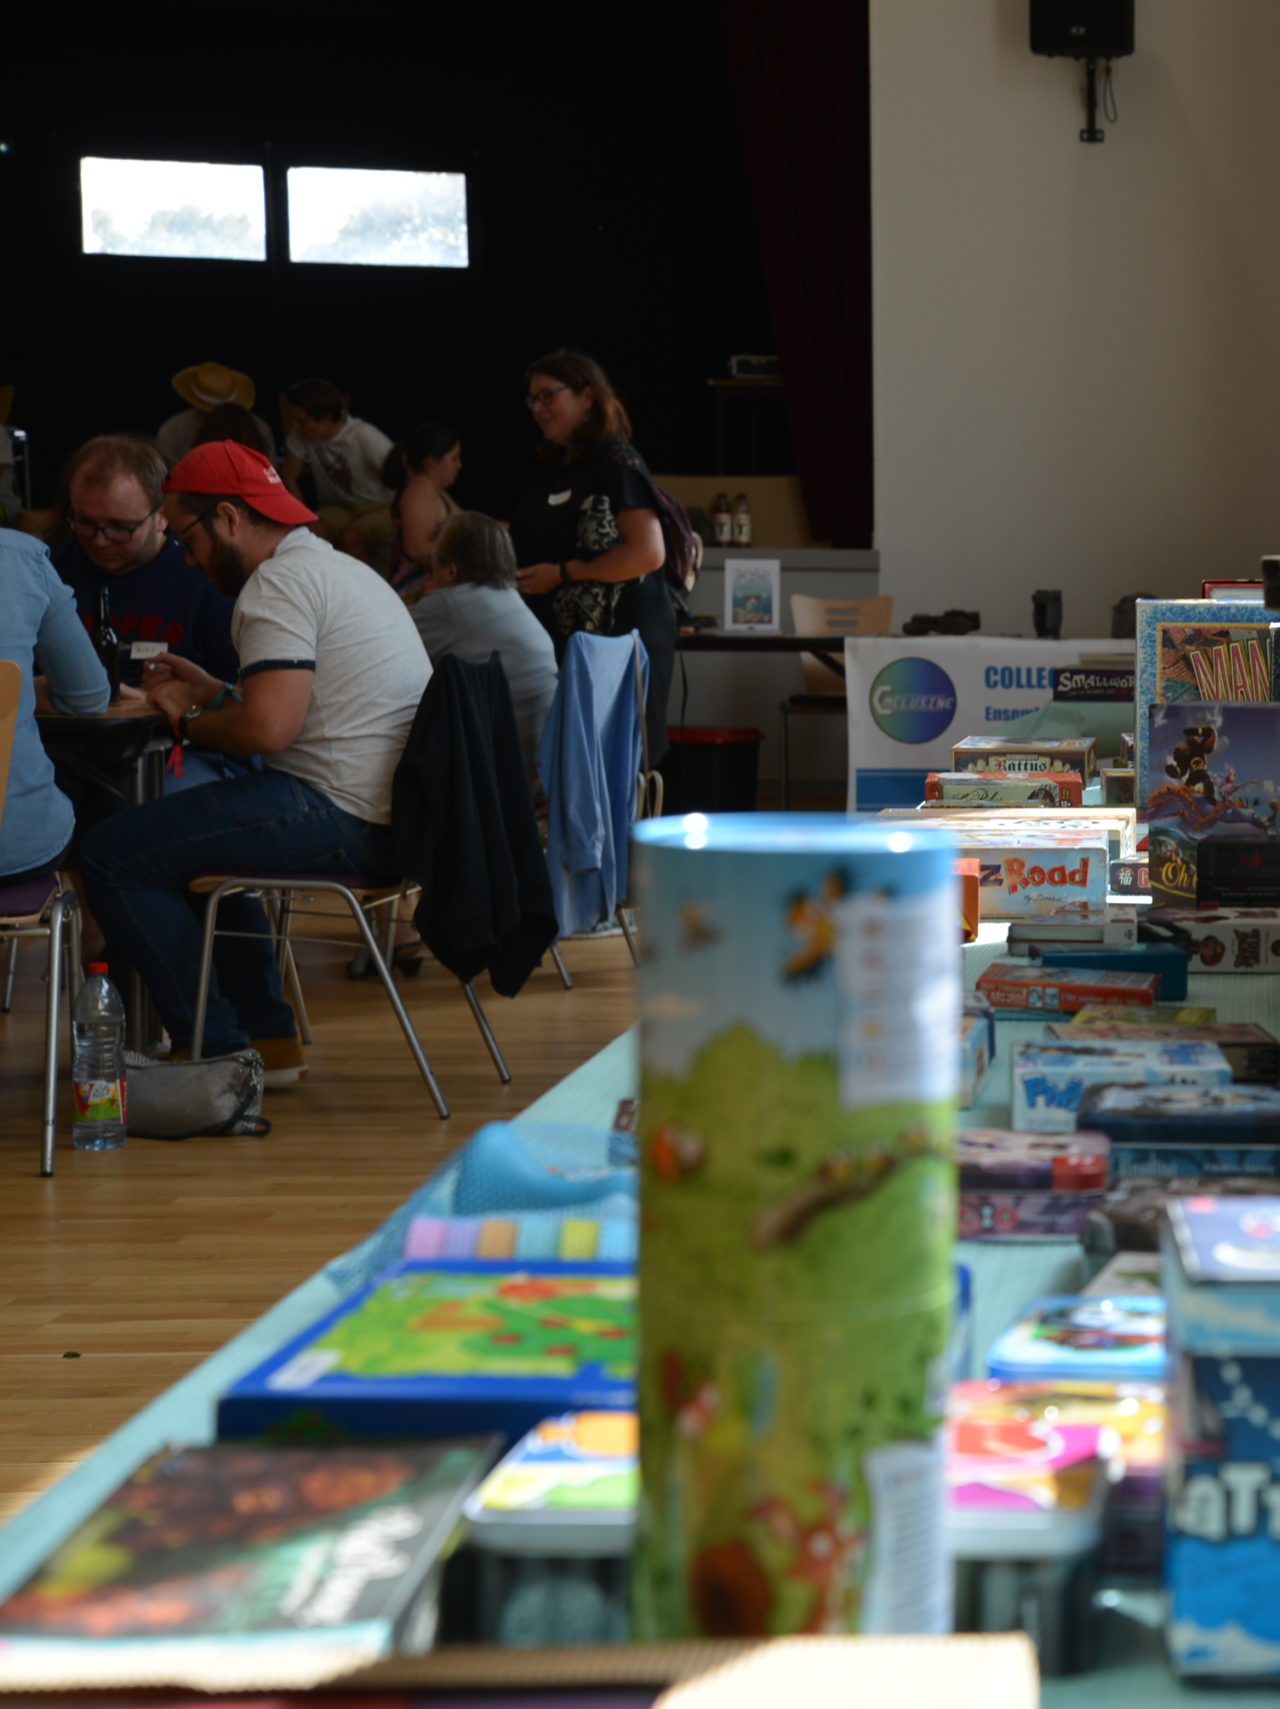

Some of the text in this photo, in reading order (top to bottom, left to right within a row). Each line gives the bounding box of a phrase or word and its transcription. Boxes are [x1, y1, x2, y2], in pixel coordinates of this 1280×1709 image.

[985, 705, 1039, 721] Ense
[994, 758, 1047, 772] Rattus
[1004, 856, 1090, 895] Road
